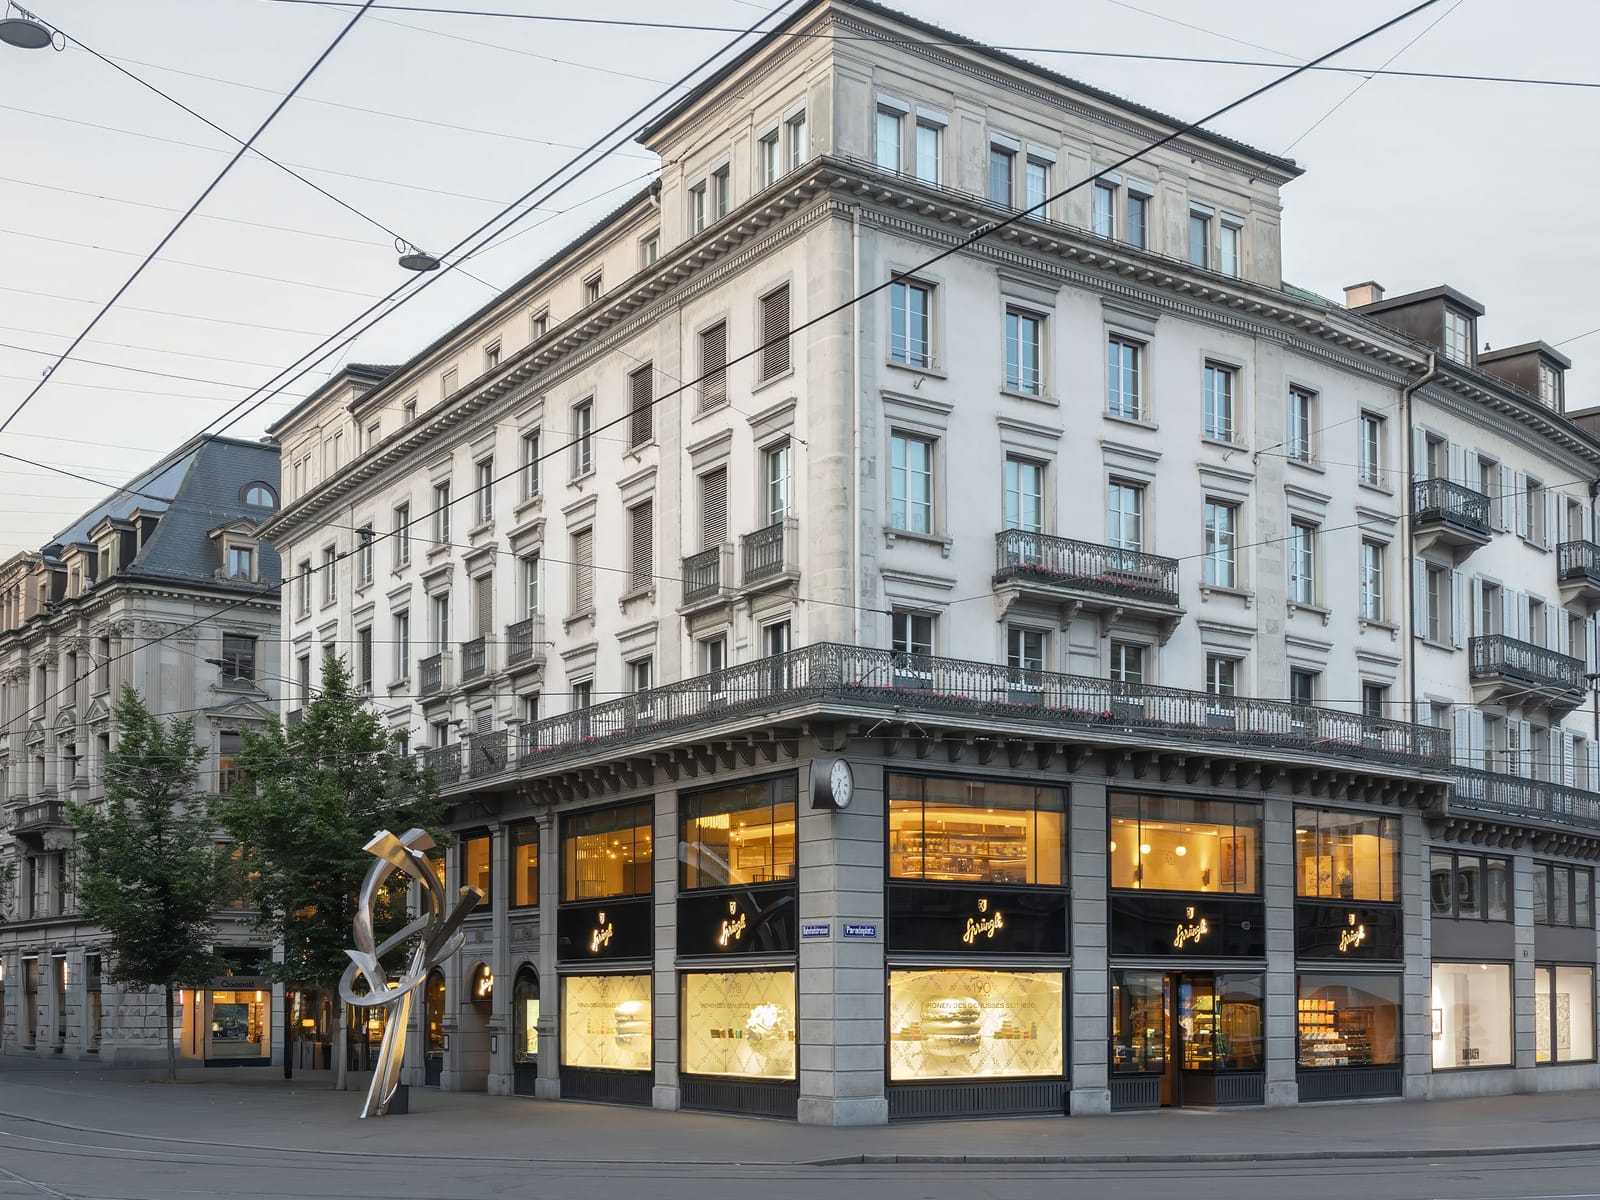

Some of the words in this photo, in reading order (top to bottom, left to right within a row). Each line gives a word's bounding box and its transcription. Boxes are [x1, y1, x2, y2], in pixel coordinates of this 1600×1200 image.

[846, 925, 874, 937] Paradeplatz
[963, 912, 1003, 943] Sprüngli
[1174, 918, 1208, 947] Sprüngli
